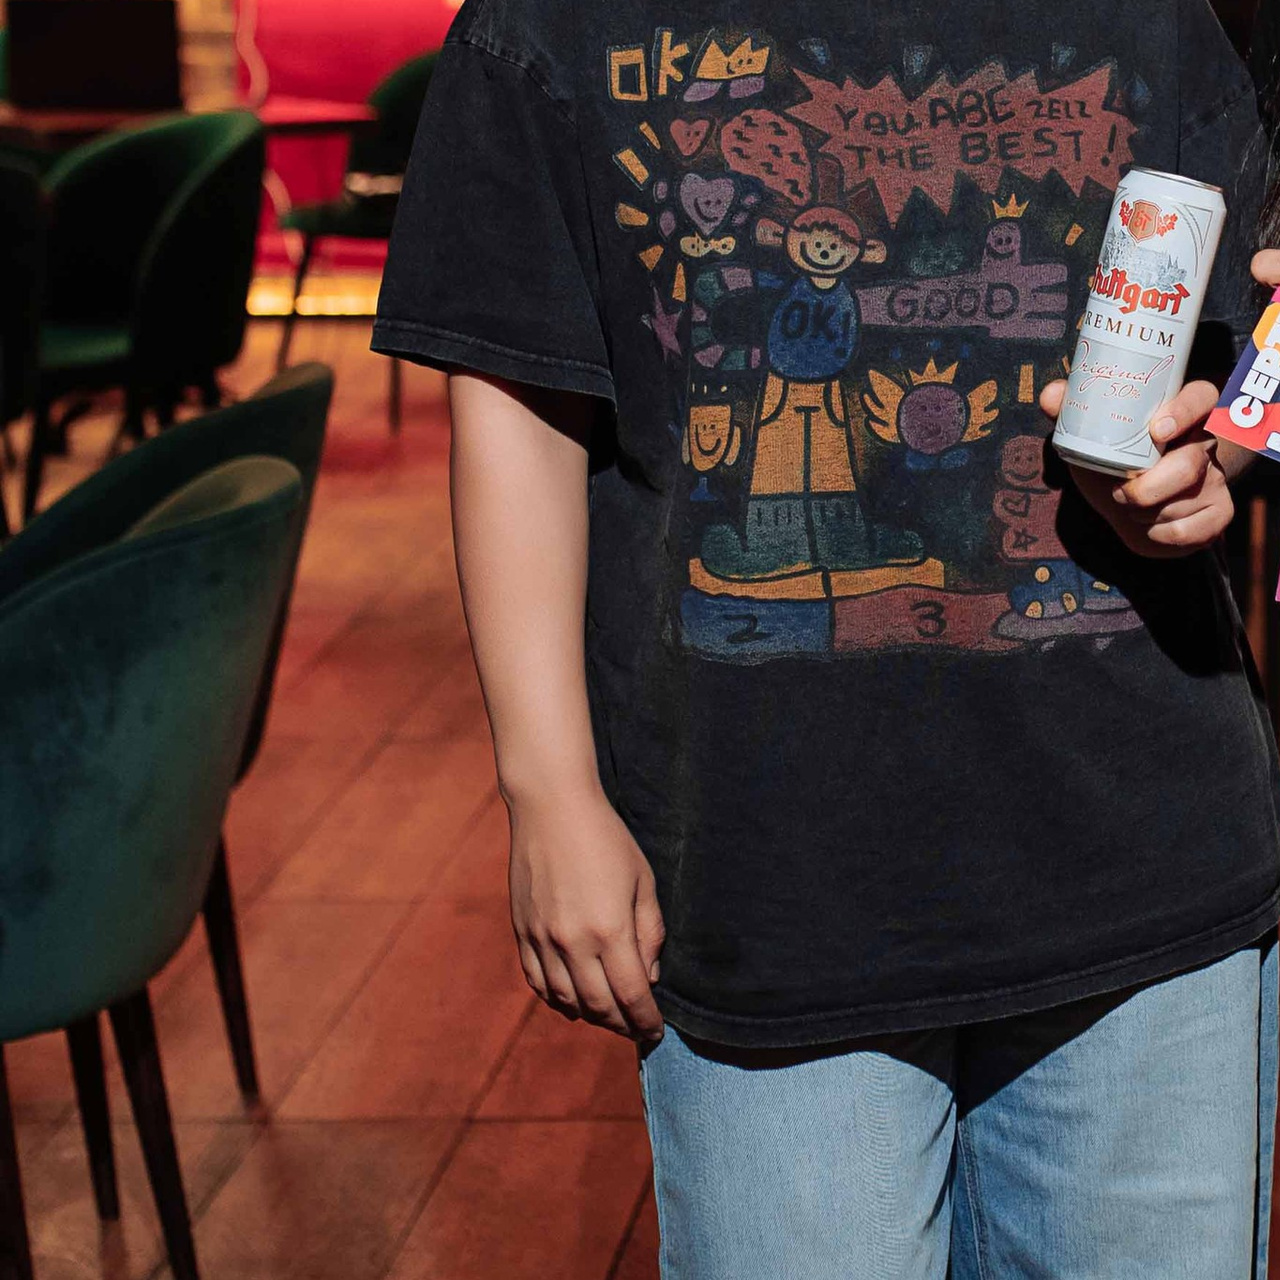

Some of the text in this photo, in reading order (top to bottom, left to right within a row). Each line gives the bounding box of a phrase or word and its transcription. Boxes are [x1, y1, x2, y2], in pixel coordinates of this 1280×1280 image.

[609, 29, 690, 102] OK
[844, 144, 933, 170] THE
[886, 282, 1020, 322] GOOD
[1084, 310, 1176, 348] REMIUM
[725, 614, 773, 644] 2
[910, 600, 948, 638] 3
